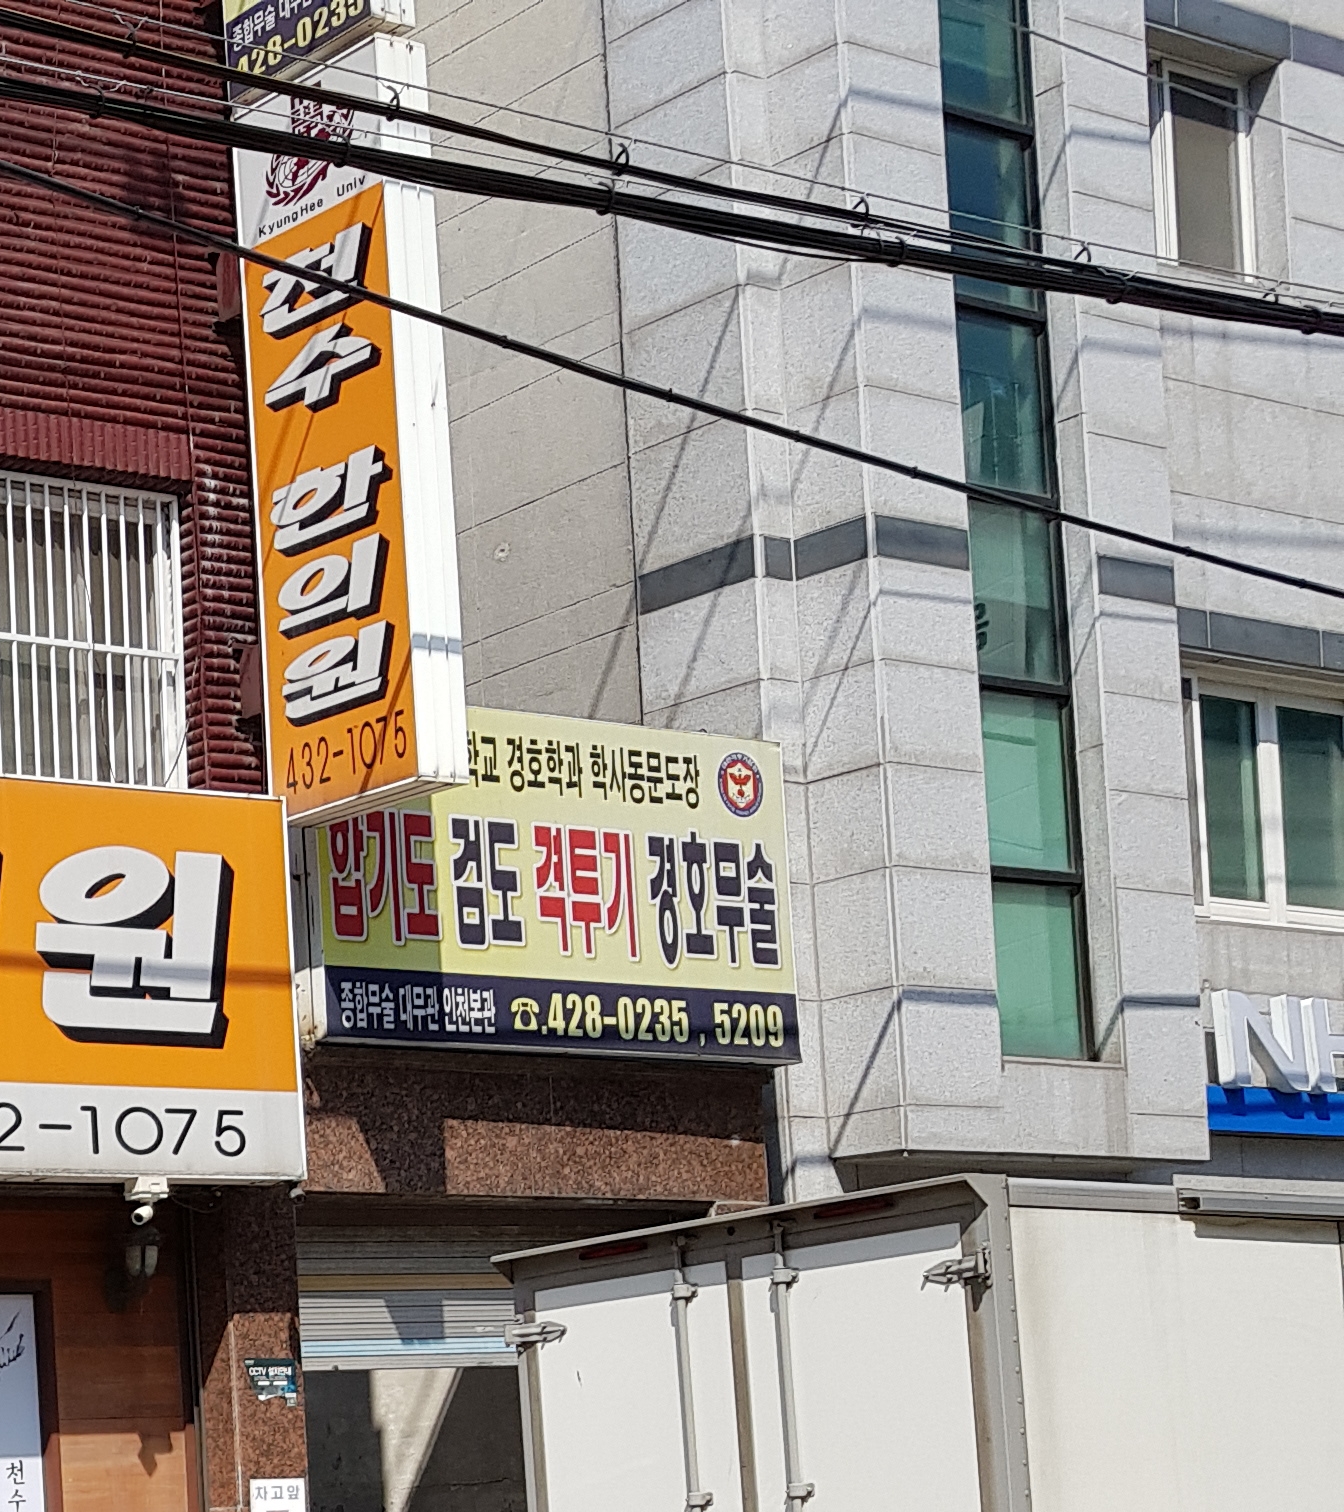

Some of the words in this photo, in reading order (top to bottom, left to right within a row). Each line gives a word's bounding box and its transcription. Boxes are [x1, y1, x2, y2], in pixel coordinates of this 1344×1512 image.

[258, 198, 324, 238] KyungHee
[336, 174, 367, 197] Univ
[259, 221, 383, 414] 천수
[269, 444, 395, 727] 한의원
[286, 709, 408, 795] 432-1075
[506, 735, 583, 799] 경호학과
[589, 744, 700, 810] 학사동문도장
[328, 808, 443, 947] 합기도
[448, 813, 526, 950] 검도
[531, 821, 641, 963] 격투기
[644, 827, 783, 970] 경호무술
[340, 981, 396, 1030] 종합무술
[398, 984, 440, 1032] 대무관
[442, 986, 497, 1034] 인천본관
[714, 1001, 786, 1048] 5209
[254, 1484, 301, 1501] 차고앞
